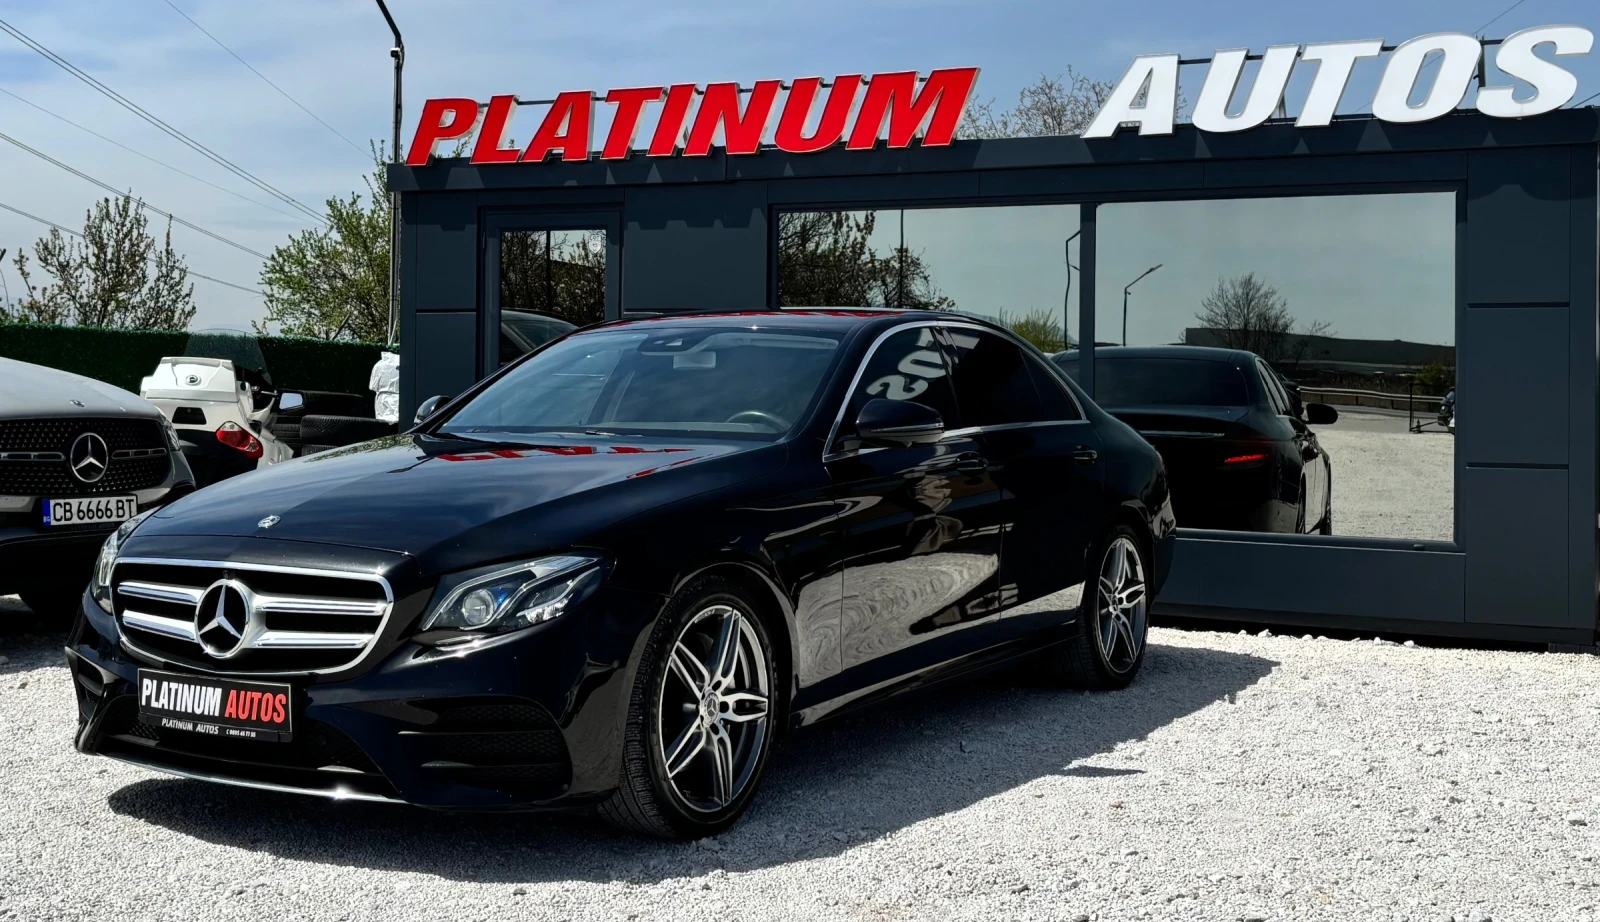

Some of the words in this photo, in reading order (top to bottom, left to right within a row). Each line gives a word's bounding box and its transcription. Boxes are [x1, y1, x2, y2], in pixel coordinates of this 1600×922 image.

[405, 66, 981, 167] PLATINUM
[1080, 24, 1594, 139] AUTOS
[53, 502, 73, 522] CB
[76, 500, 113, 521] 6666
[116, 499, 134, 518] BT
[142, 678, 222, 716] PLATINUM
[225, 690, 287, 723] AUTOS
[161, 718, 193, 731] PLATINUM
[195, 723, 219, 735] AUTOS
